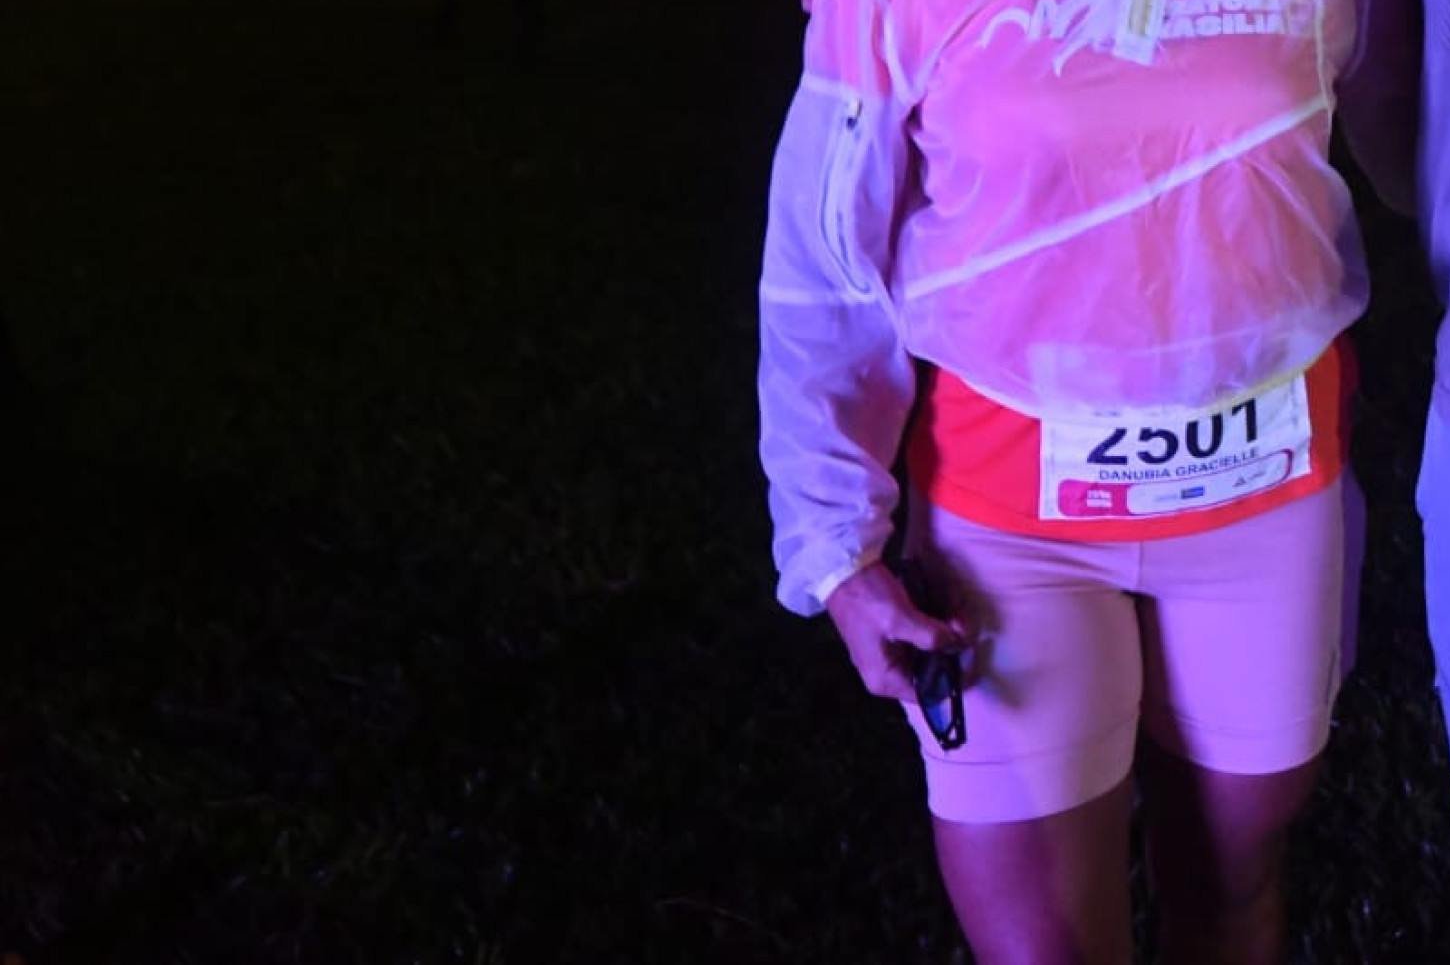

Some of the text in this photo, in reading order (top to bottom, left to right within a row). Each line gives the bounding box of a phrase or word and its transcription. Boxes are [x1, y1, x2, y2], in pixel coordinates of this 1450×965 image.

[1087, 397, 1258, 465] 2501
[1099, 448, 1260, 481] DANUBIA GRACIELLE
